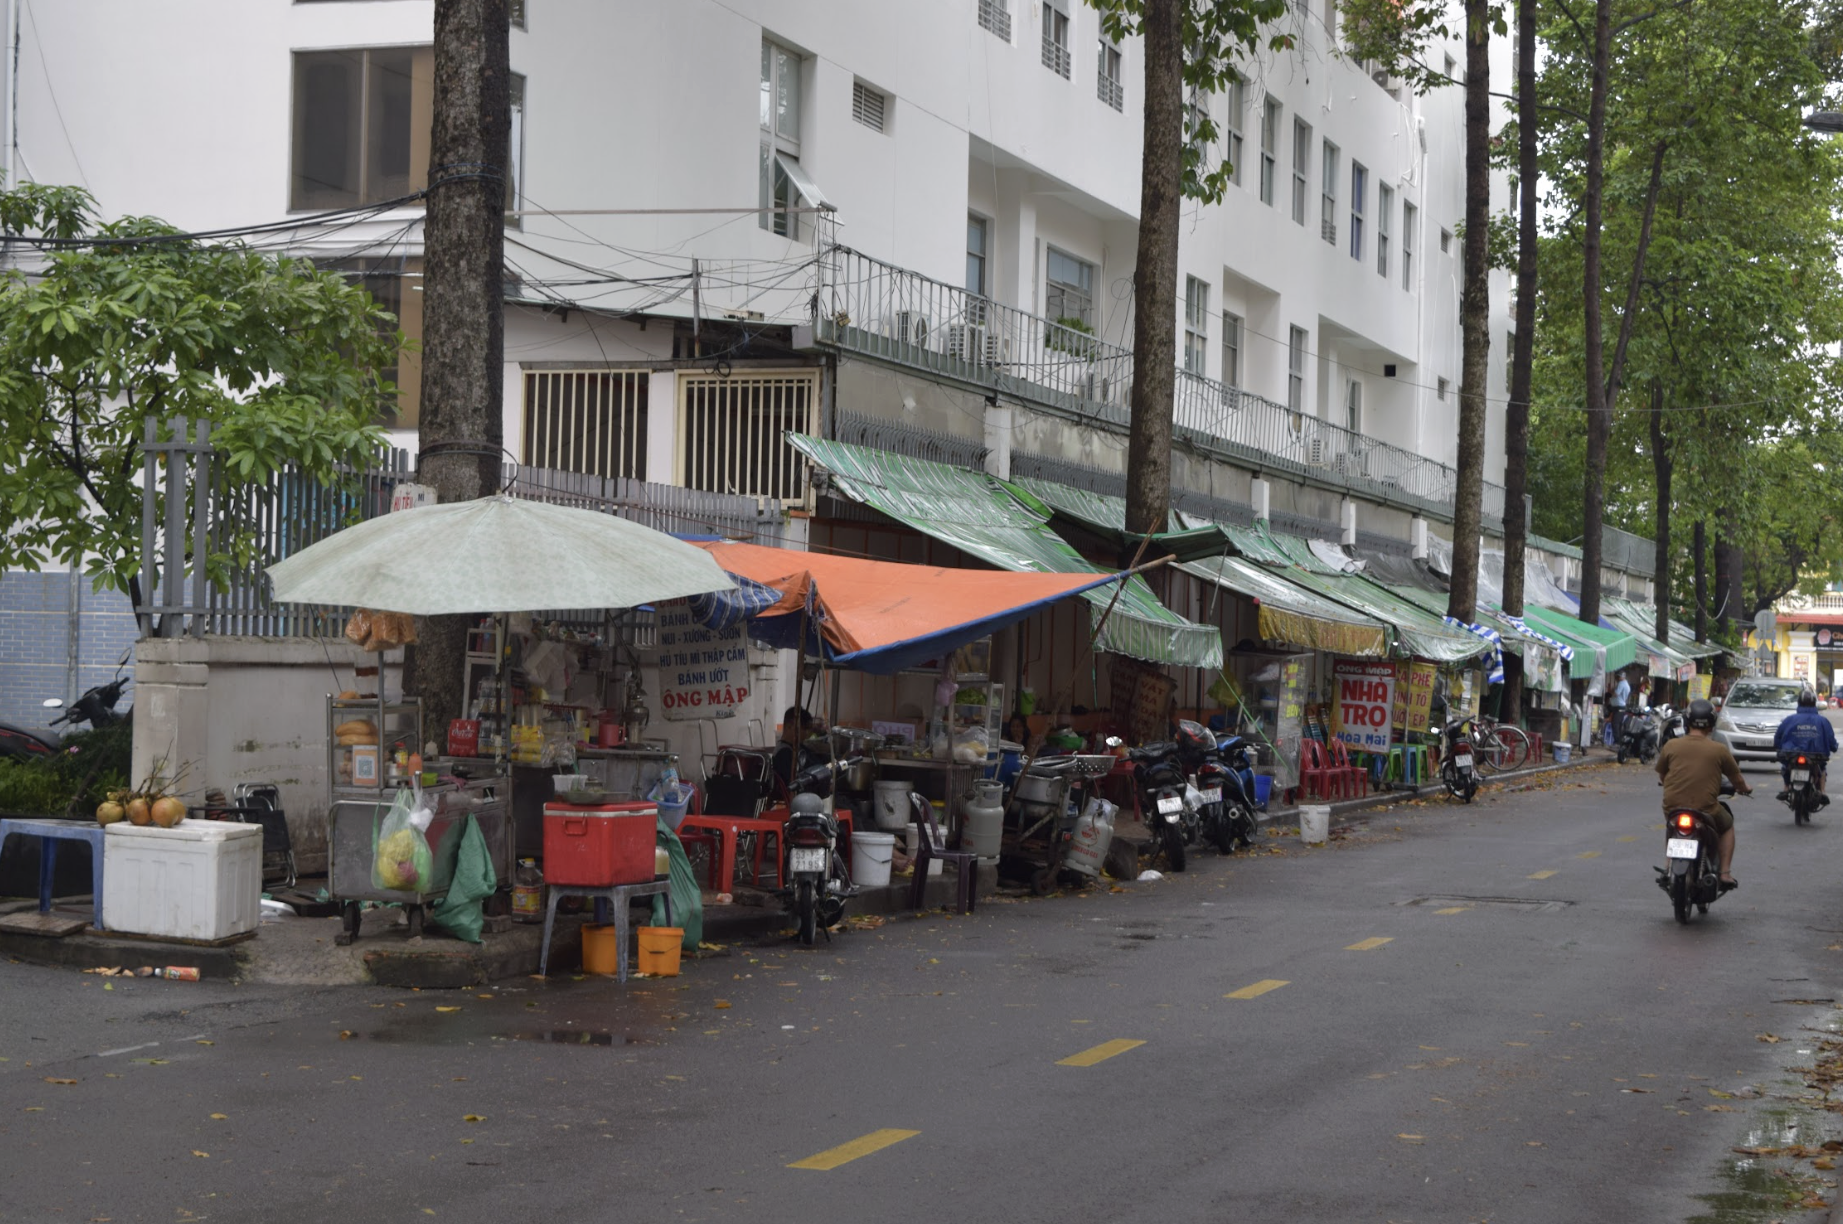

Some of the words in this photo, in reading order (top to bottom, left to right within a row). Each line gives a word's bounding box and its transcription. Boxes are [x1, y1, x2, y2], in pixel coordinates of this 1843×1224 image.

[661, 611, 688, 627] BÁNH
[661, 632, 676, 646] NUI
[702, 647, 724, 665] THẬP
[678, 669, 706, 686] BÁNH
[709, 667, 729, 683] ƯỚT
[1411, 670, 1432, 688] PHÊ
[663, 688, 702, 709] ÔNG
[707, 684, 748, 707] MẬP
[1341, 676, 1388, 704] NHÀ
[1341, 703, 1386, 732] TRỌ
[1337, 731, 1361, 743] Hoa
[1366, 733, 1386, 746] Mai
